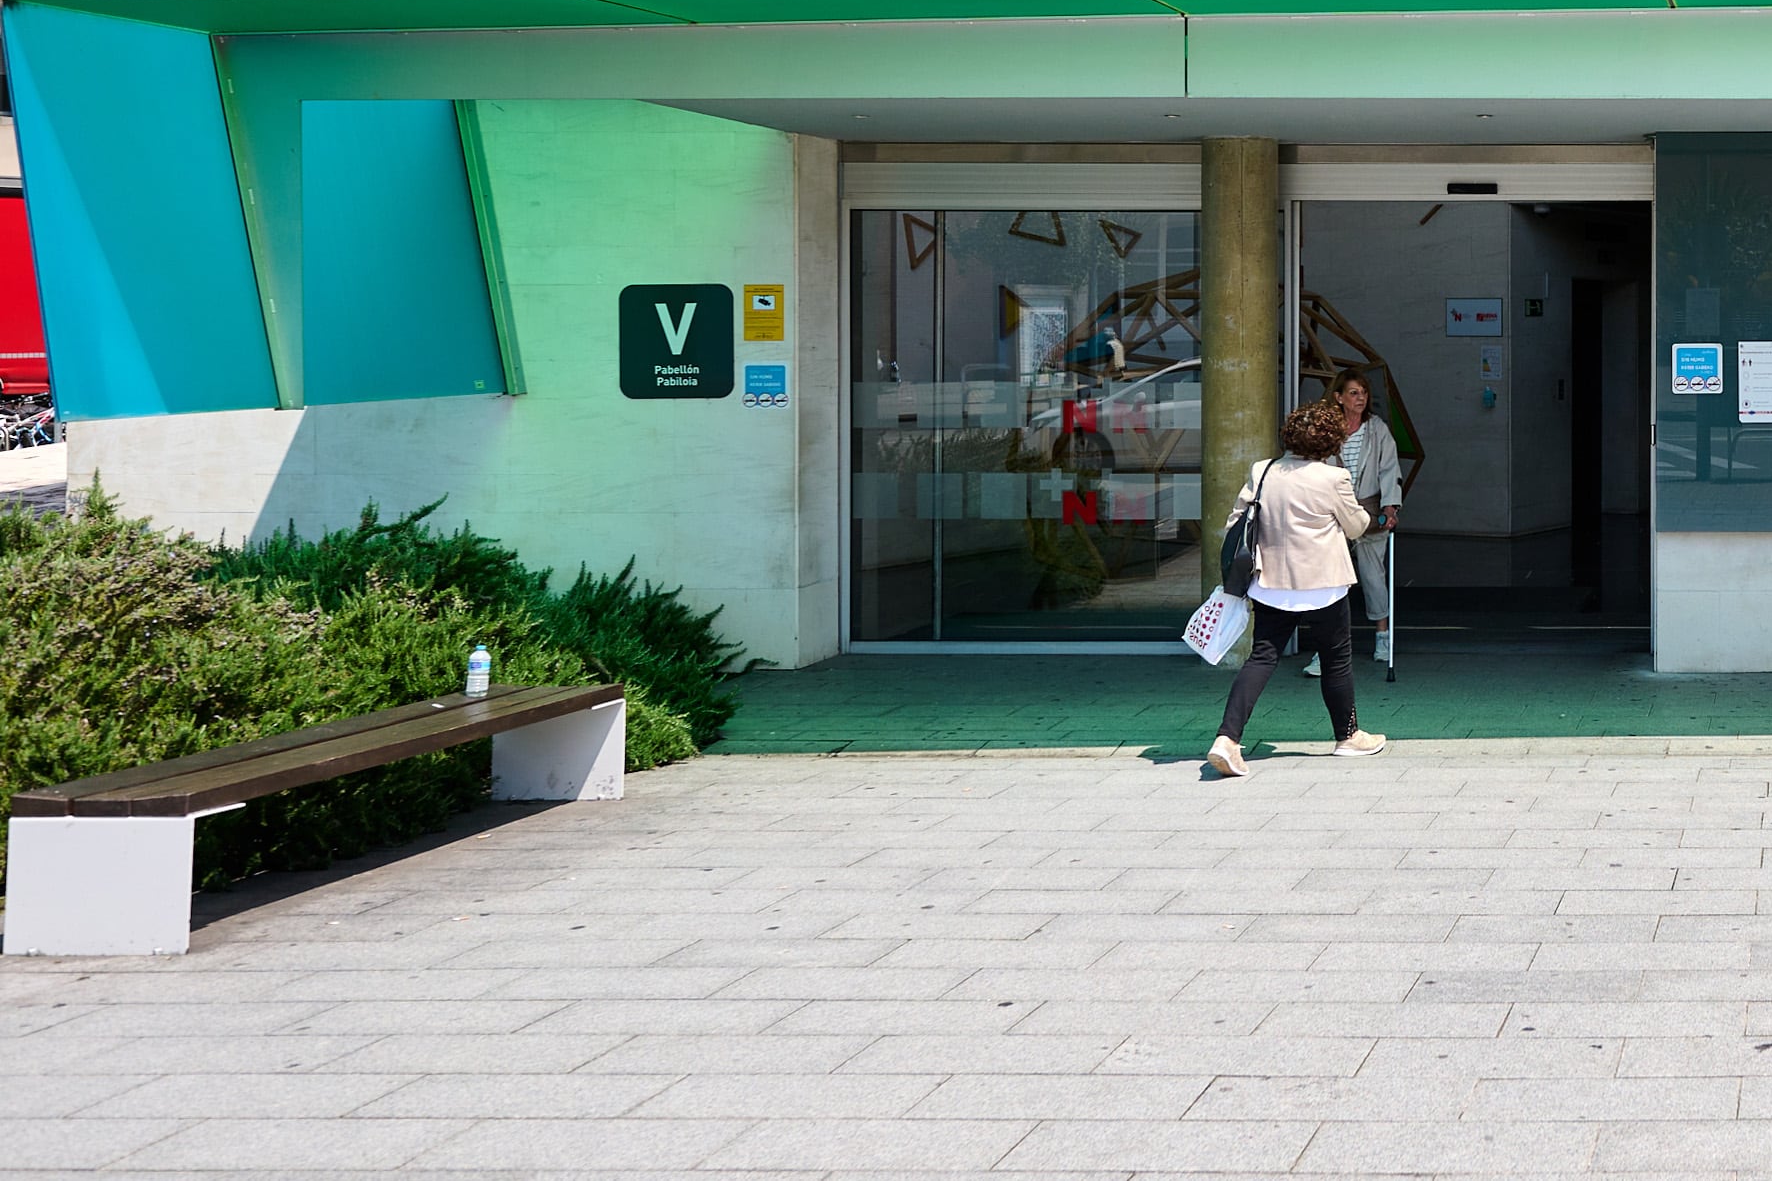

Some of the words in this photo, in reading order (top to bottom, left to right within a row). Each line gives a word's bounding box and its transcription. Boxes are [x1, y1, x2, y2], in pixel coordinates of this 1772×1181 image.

[655, 303, 697, 355] V
[654, 364, 700, 375] Pabellón
[656, 376, 698, 387] Pabiloia
[1062, 491, 1097, 525] N
